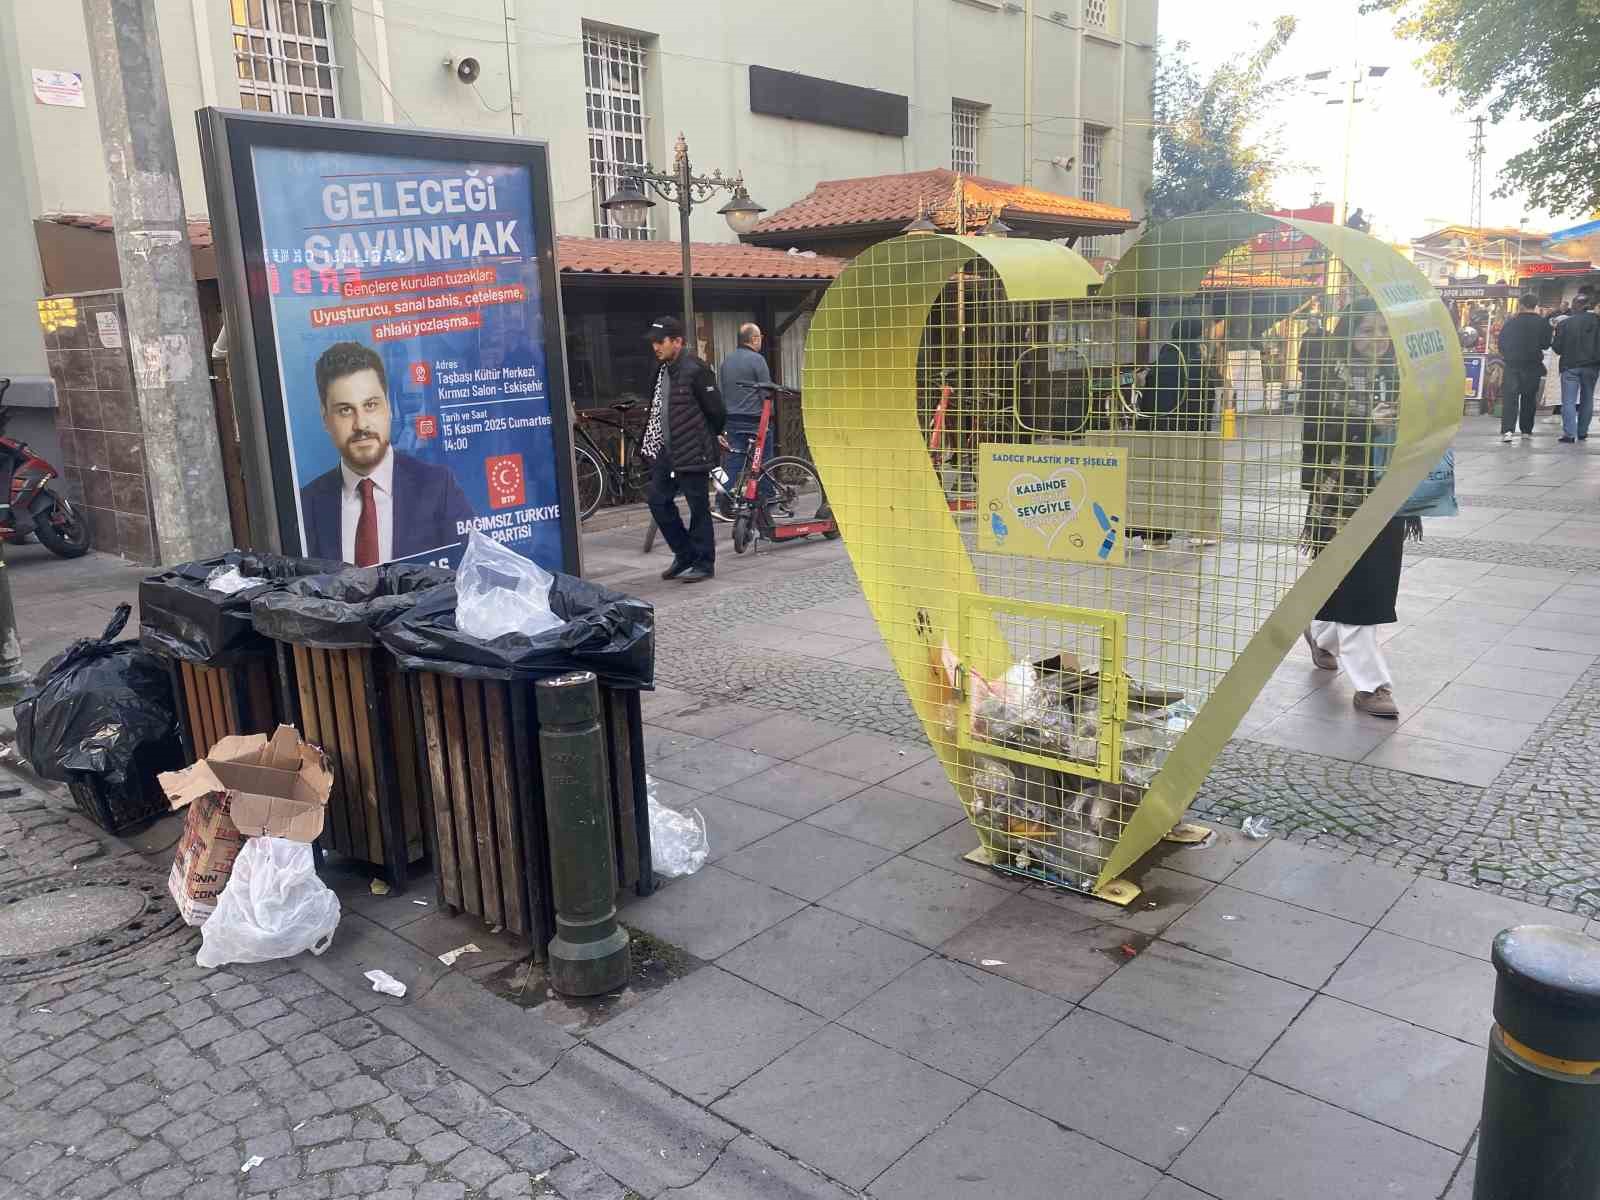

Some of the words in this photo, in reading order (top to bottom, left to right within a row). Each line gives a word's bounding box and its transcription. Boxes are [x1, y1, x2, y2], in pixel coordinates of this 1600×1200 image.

[322, 169, 497, 221] GELECEĞİ
[304, 220, 521, 272] SAVUNMAK
[344, 278, 399, 297] Gençlere
[400, 274, 444, 291] kurulan
[445, 268, 493, 285] tuzaklar:
[313, 305, 392, 326] Uyuşturucu,
[394, 296, 425, 313] sanal
[428, 294, 462, 310] bahis,
[465, 288, 522, 306] çeteleşme,
[376, 321, 411, 339] ahlaki
[414, 316, 479, 337] yozlaşma...
[435, 360, 458, 370] Adres
[437, 370, 473, 385] Taşbaşı
[474, 367, 502, 381] Kültür
[503, 365, 536, 379] Merkezi
[438, 386, 470, 400] Kırmızı
[472, 383, 497, 397] Salon
[504, 379, 544, 395] Eskişehir
[441, 412, 461, 423] Tarih
[461, 411, 470, 421] ve
[471, 409, 488, 419] Saat
[443, 424, 453, 437] 15
[454, 420, 482, 435] Kasım
[484, 417, 506, 432] 2025
[444, 436, 468, 452] 14:00
[992, 453, 1025, 464] SADECE
[1027, 454, 1062, 465] PLASTİK
[1064, 456, 1081, 466] PET
[1016, 479, 1067, 496] KALBİNDE
[514, 504, 561, 524] TÜRKİYE
[1016, 500, 1072, 518] SEVGİYLE
